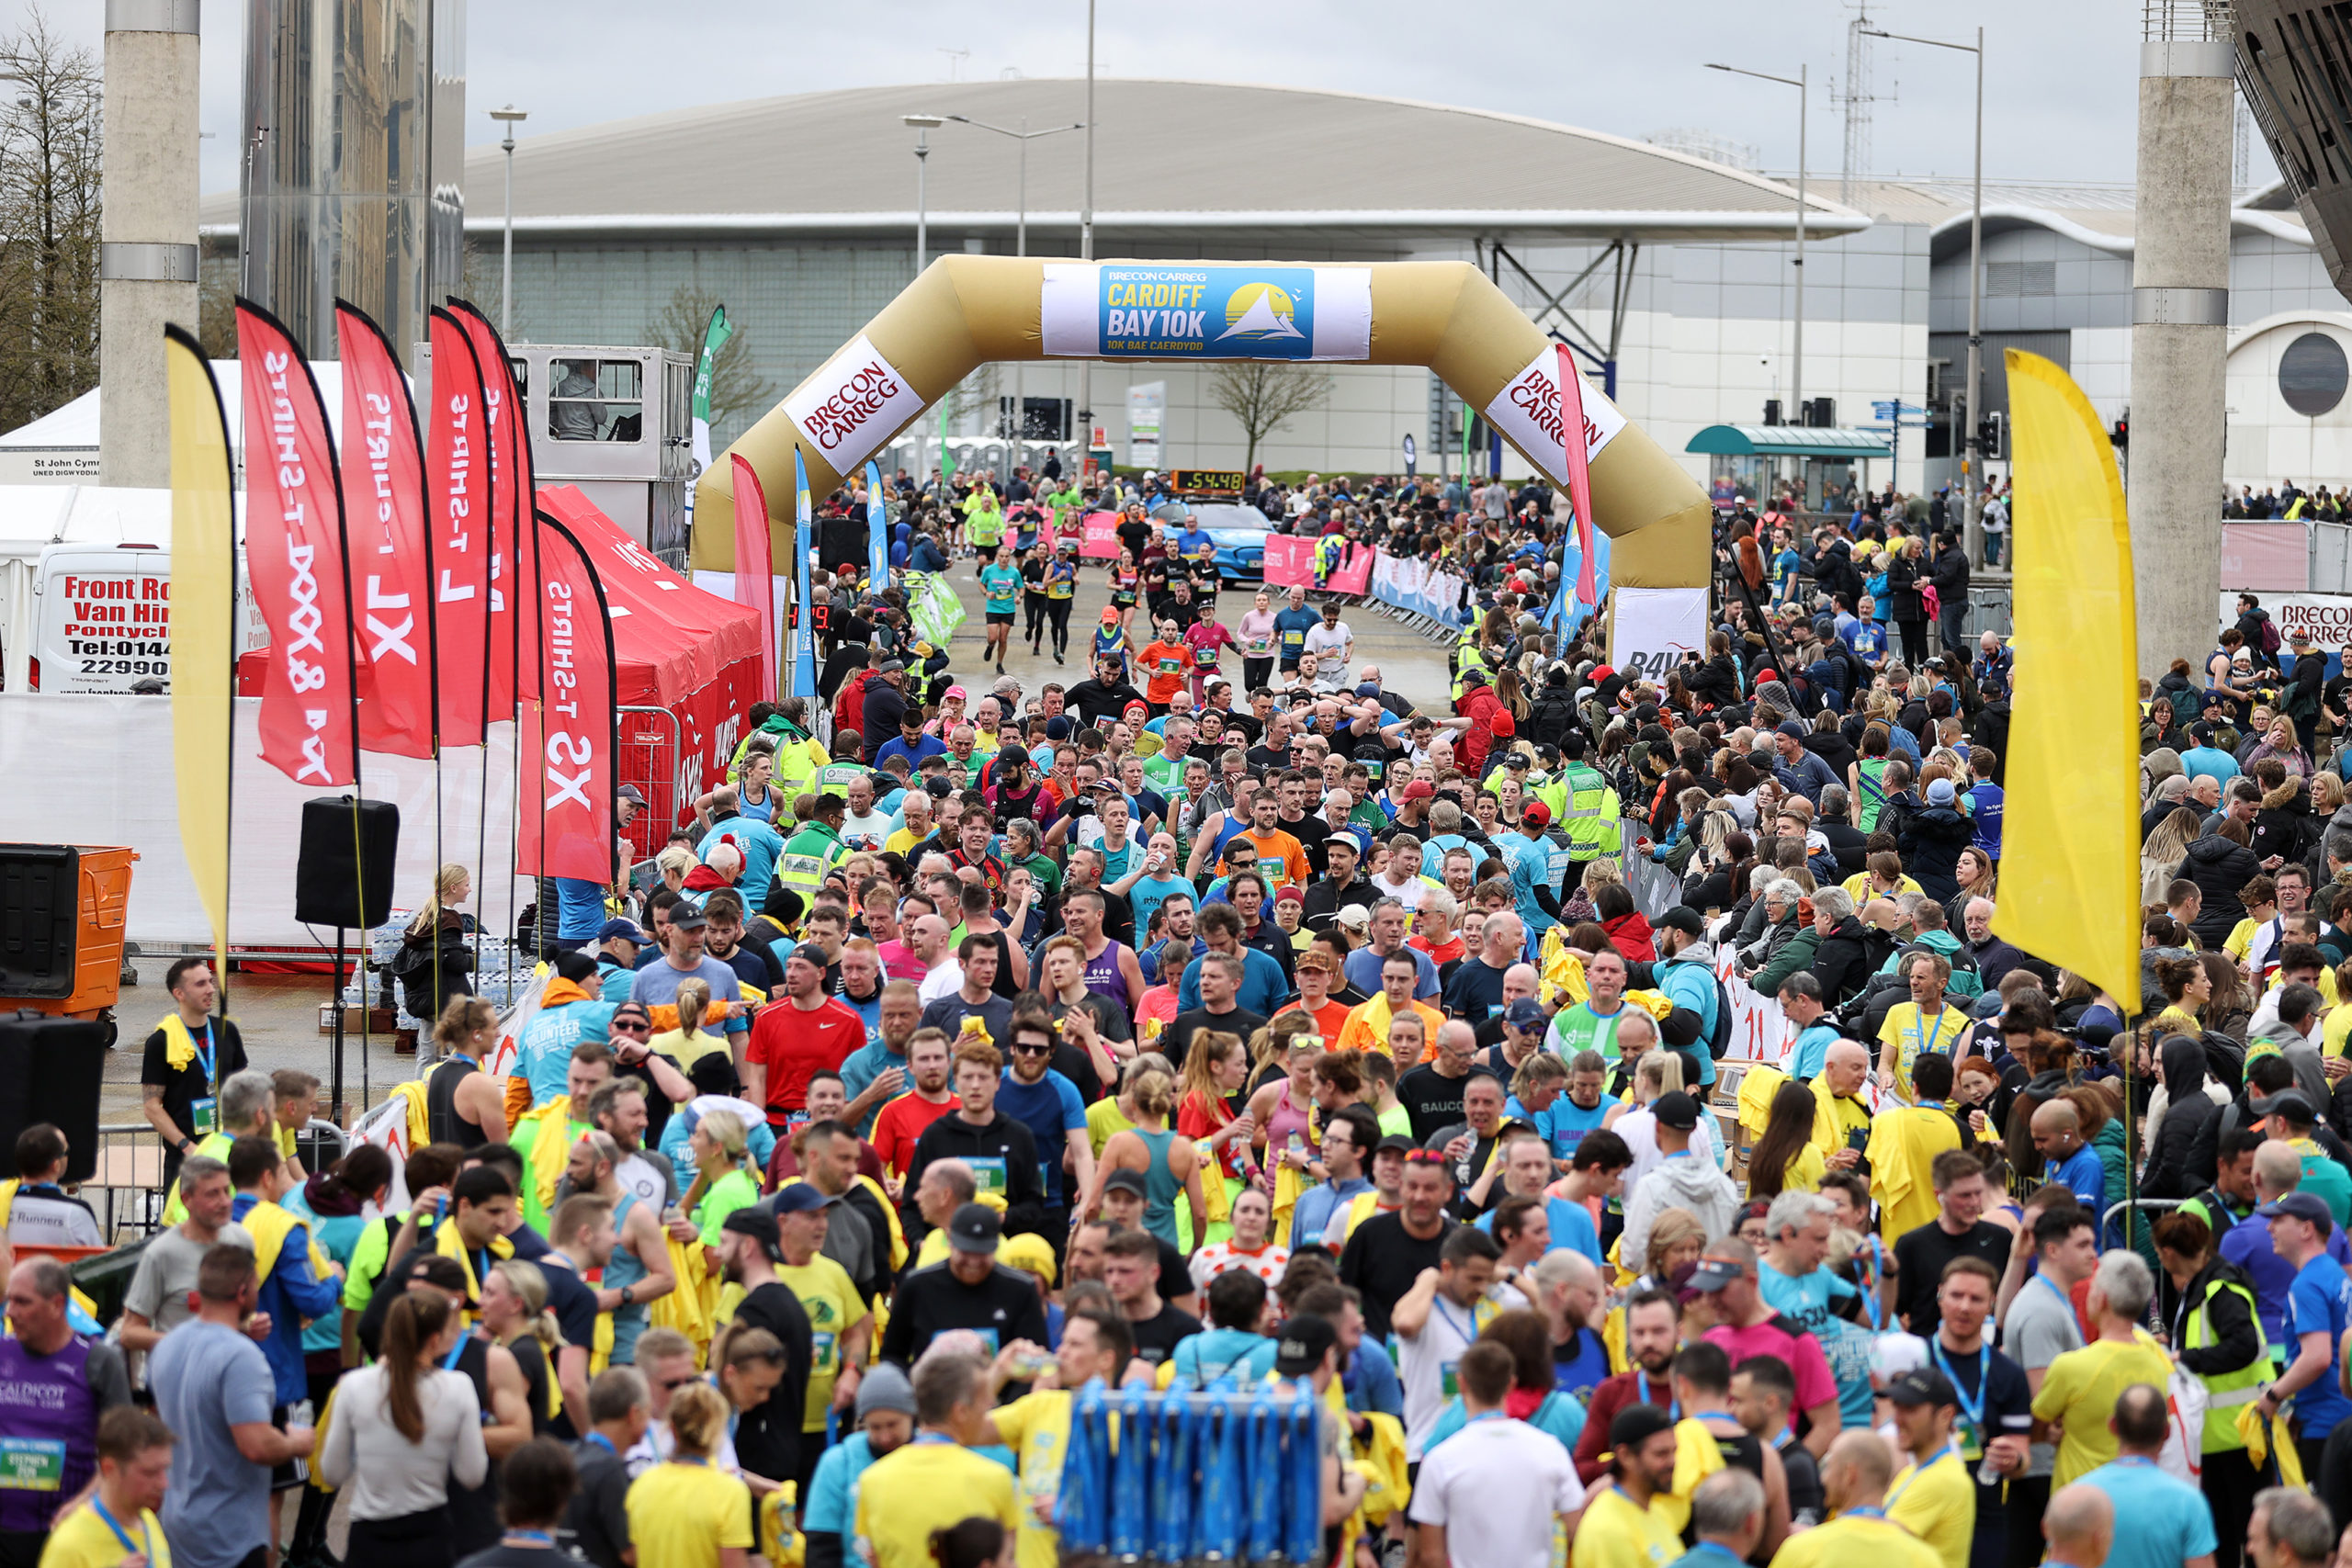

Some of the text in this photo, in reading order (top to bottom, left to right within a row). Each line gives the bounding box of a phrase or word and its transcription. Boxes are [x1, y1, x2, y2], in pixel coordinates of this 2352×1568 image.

[1109, 271, 1207, 282] BRECON CARREG
[1107, 283, 1206, 308] CARDIFF
[1107, 309, 1206, 338] BAY 10K
[1107, 340, 1204, 351] 10K BAE CAERDYDD
[803, 361, 886, 437] BRECON
[819, 378, 899, 451] CARREG
[1510, 385, 1566, 448] CARRE
[34, 458, 100, 468] St John Cymr
[64, 576, 171, 601] Front Ro
[74, 602, 170, 623] Van Hir
[2282, 605, 2352, 625] BRECO
[80, 660, 171, 676] 22990
[1420, 1100, 1464, 1113] SAUCO
[17, 1211, 64, 1227] Runners
